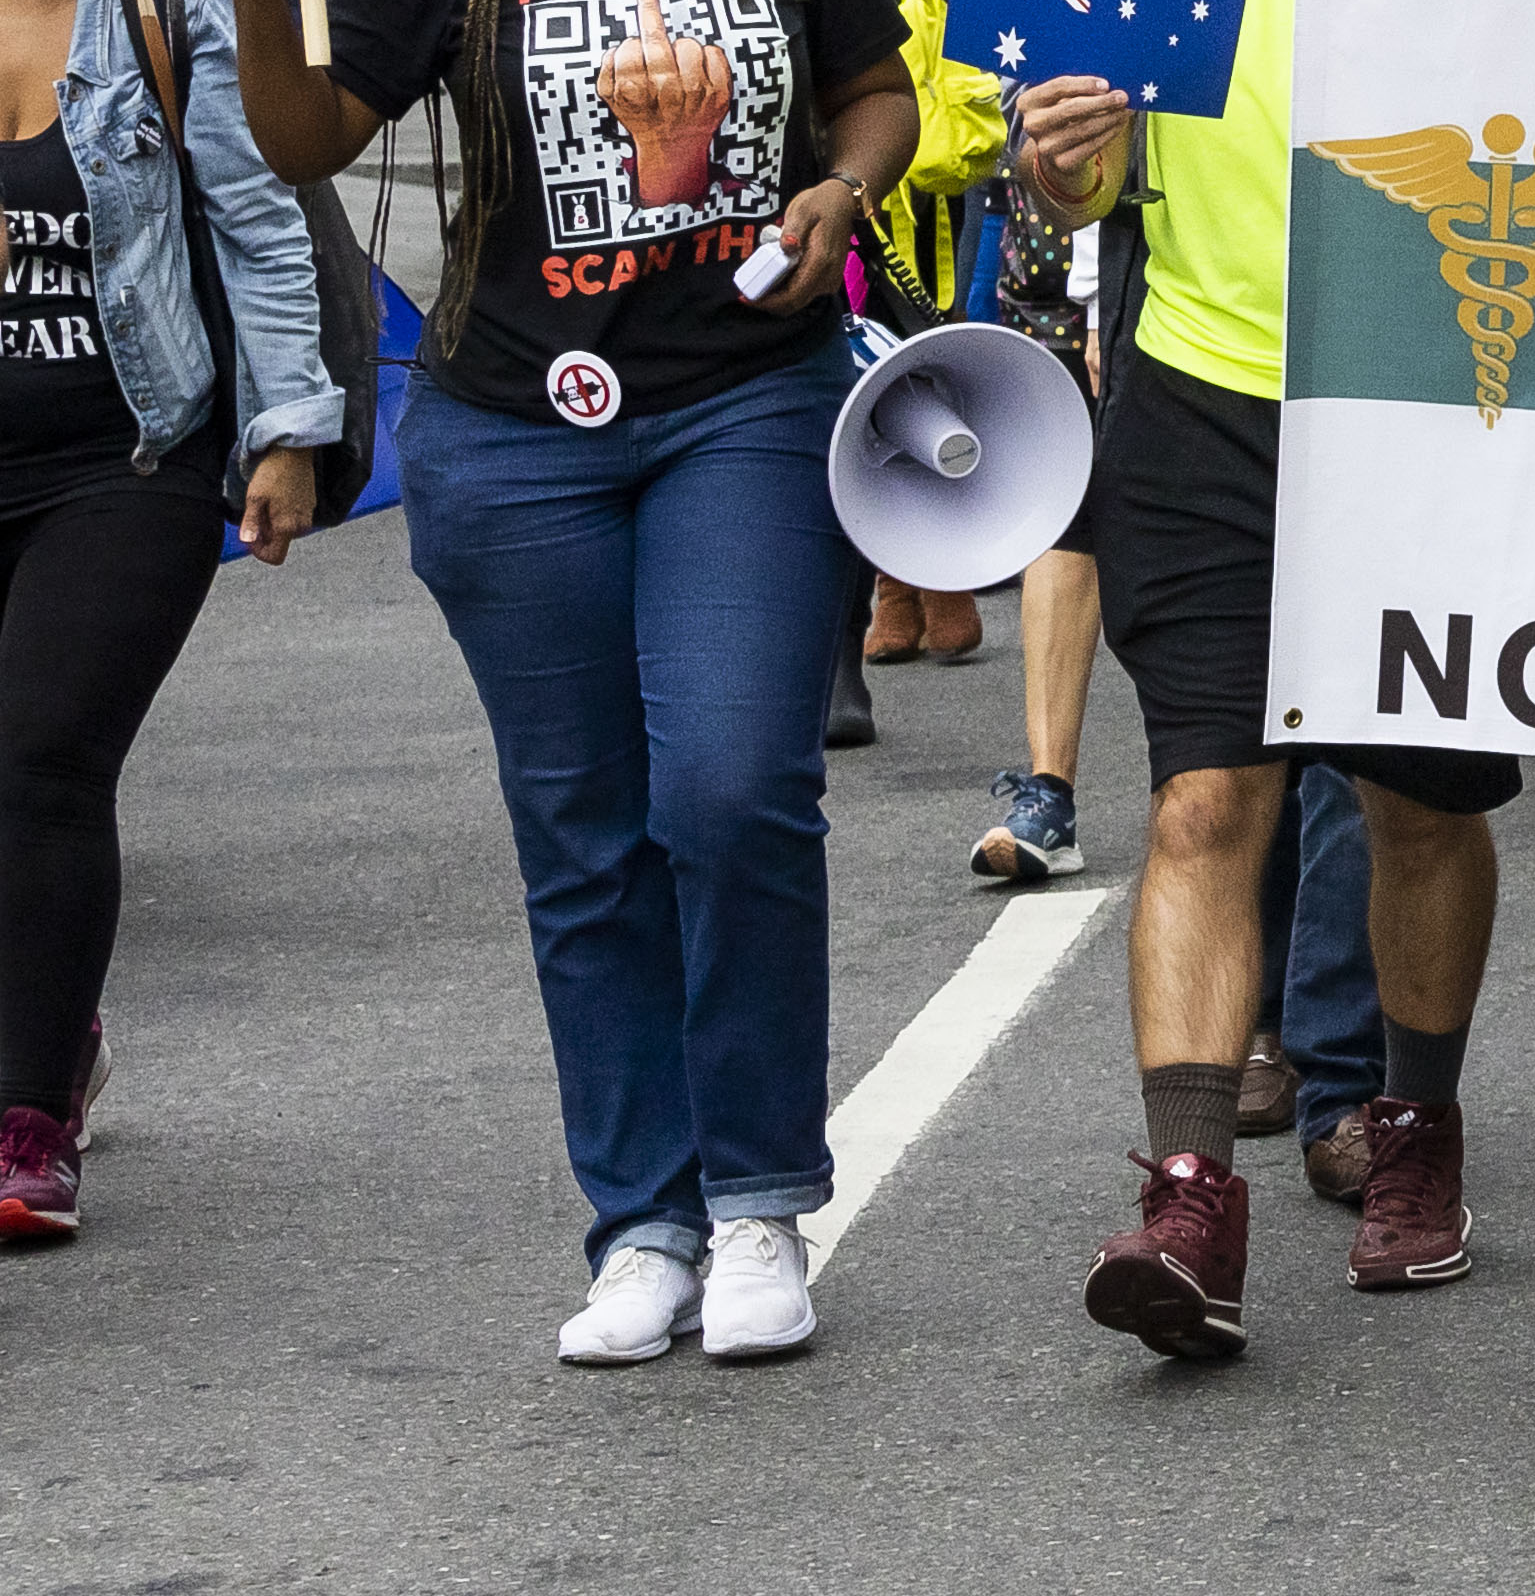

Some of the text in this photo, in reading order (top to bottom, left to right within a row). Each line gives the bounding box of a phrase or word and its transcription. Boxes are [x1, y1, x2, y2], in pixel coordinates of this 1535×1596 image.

[0, 209, 93, 250] EDO
[3, 255, 93, 298] VER
[540, 239, 676, 300] SCAN
[0, 314, 99, 360] EAR
